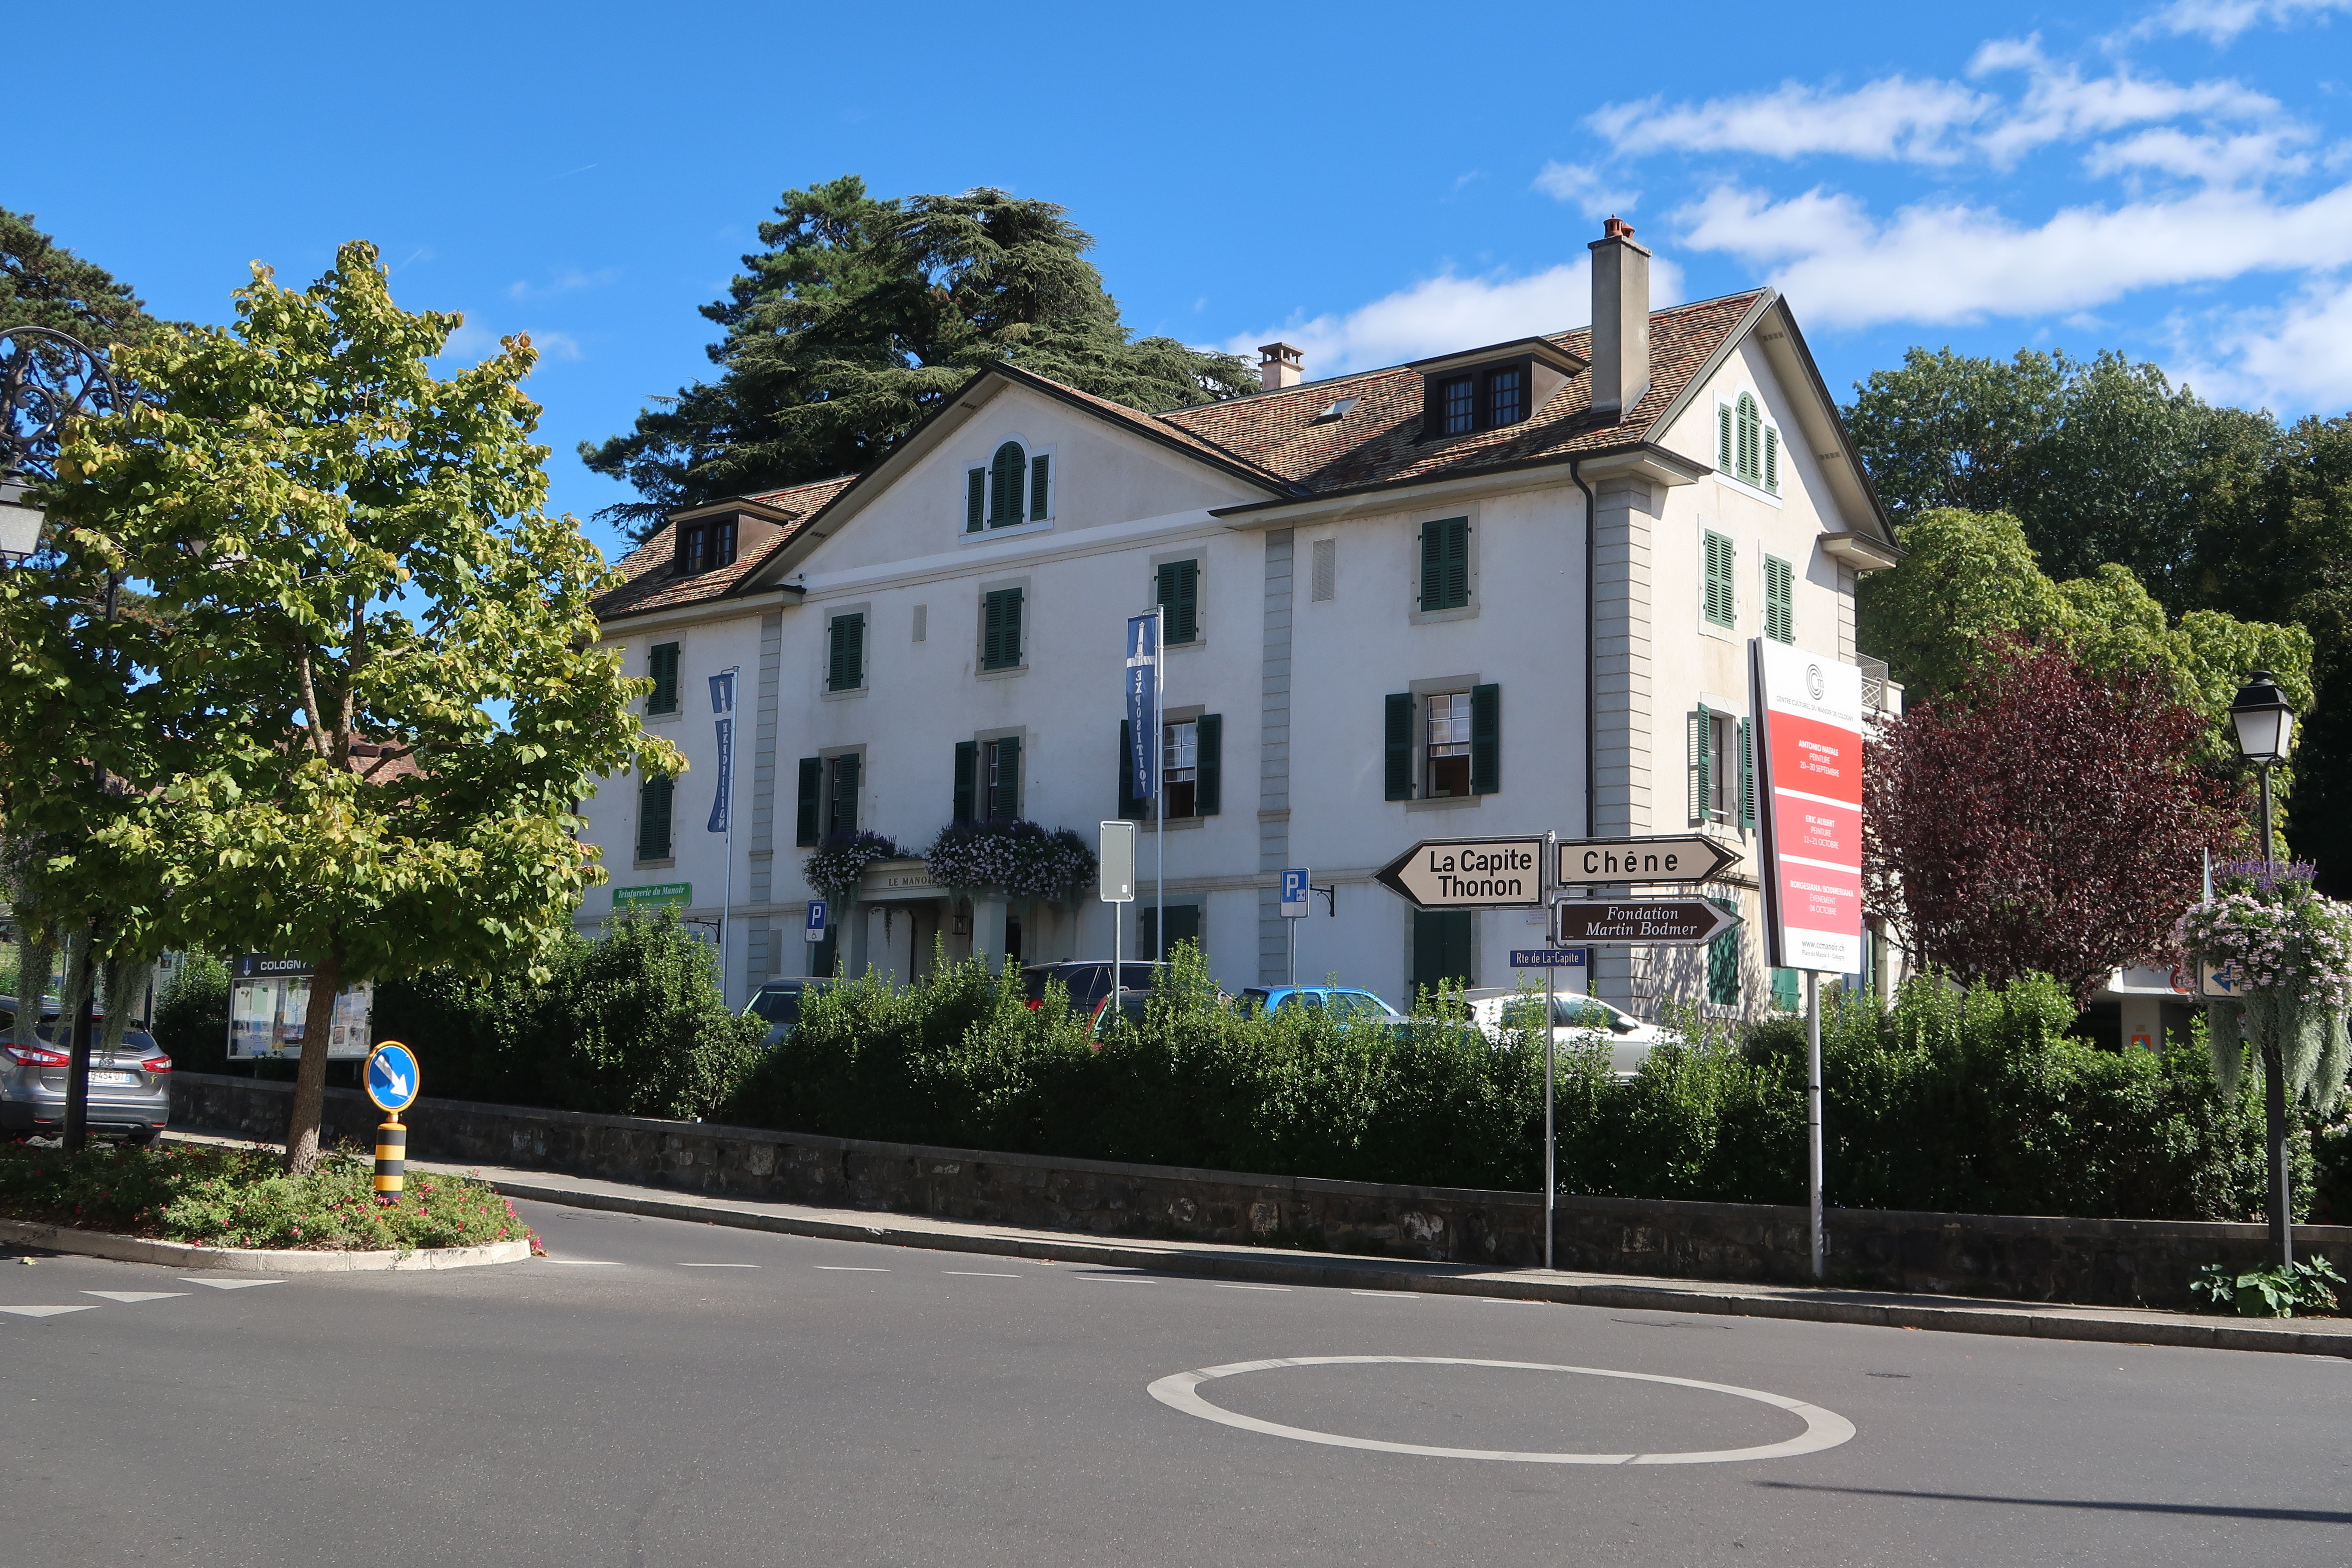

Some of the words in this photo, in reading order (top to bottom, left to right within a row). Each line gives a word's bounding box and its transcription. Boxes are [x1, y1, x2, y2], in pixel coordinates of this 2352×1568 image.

[1776, 695, 1791, 704] CENTRE
[1792, 699, 1810, 710] CULTUREL
[1817, 706, 1832, 716] MANOIR
[1798, 739, 1822, 752] ANTONIO
[1822, 745, 1839, 756] NATALE
[1810, 752, 1831, 765] PEINTURE
[1816, 764, 1840, 777] SEPTEMBRE
[1806, 815, 1816, 824] ERIC
[1817, 817, 1835, 827] ALIBERT
[1811, 826, 1832, 837] PEINTURE
[1818, 838, 1839, 849] OCTOBRE
[1430, 851, 1455, 872] La
[1461, 848, 1532, 876] Capite
[1583, 851, 1678, 873] Chêne
[888, 878, 898, 886] LE
[1286, 874, 1298, 897] P
[1438, 875, 1521, 897] Thonon
[618, 888, 652, 898] Teinturerie
[652, 887, 660, 896] du
[662, 885, 685, 895] Manoir
[812, 906, 821, 925] P
[1606, 906, 1679, 920] Fondation
[1809, 904, 1816, 912] 04
[1816, 905, 1837, 916] OCTOBRE
[1586, 922, 1634, 936] Martin
[1639, 922, 1697, 935] Bodmer
[1802, 941, 1844, 952] www.ccmanoir.ch
[1517, 952, 1528, 964] Rte
[1531, 952, 1540, 963] de
[1543, 952, 1579, 966] La-Capite
